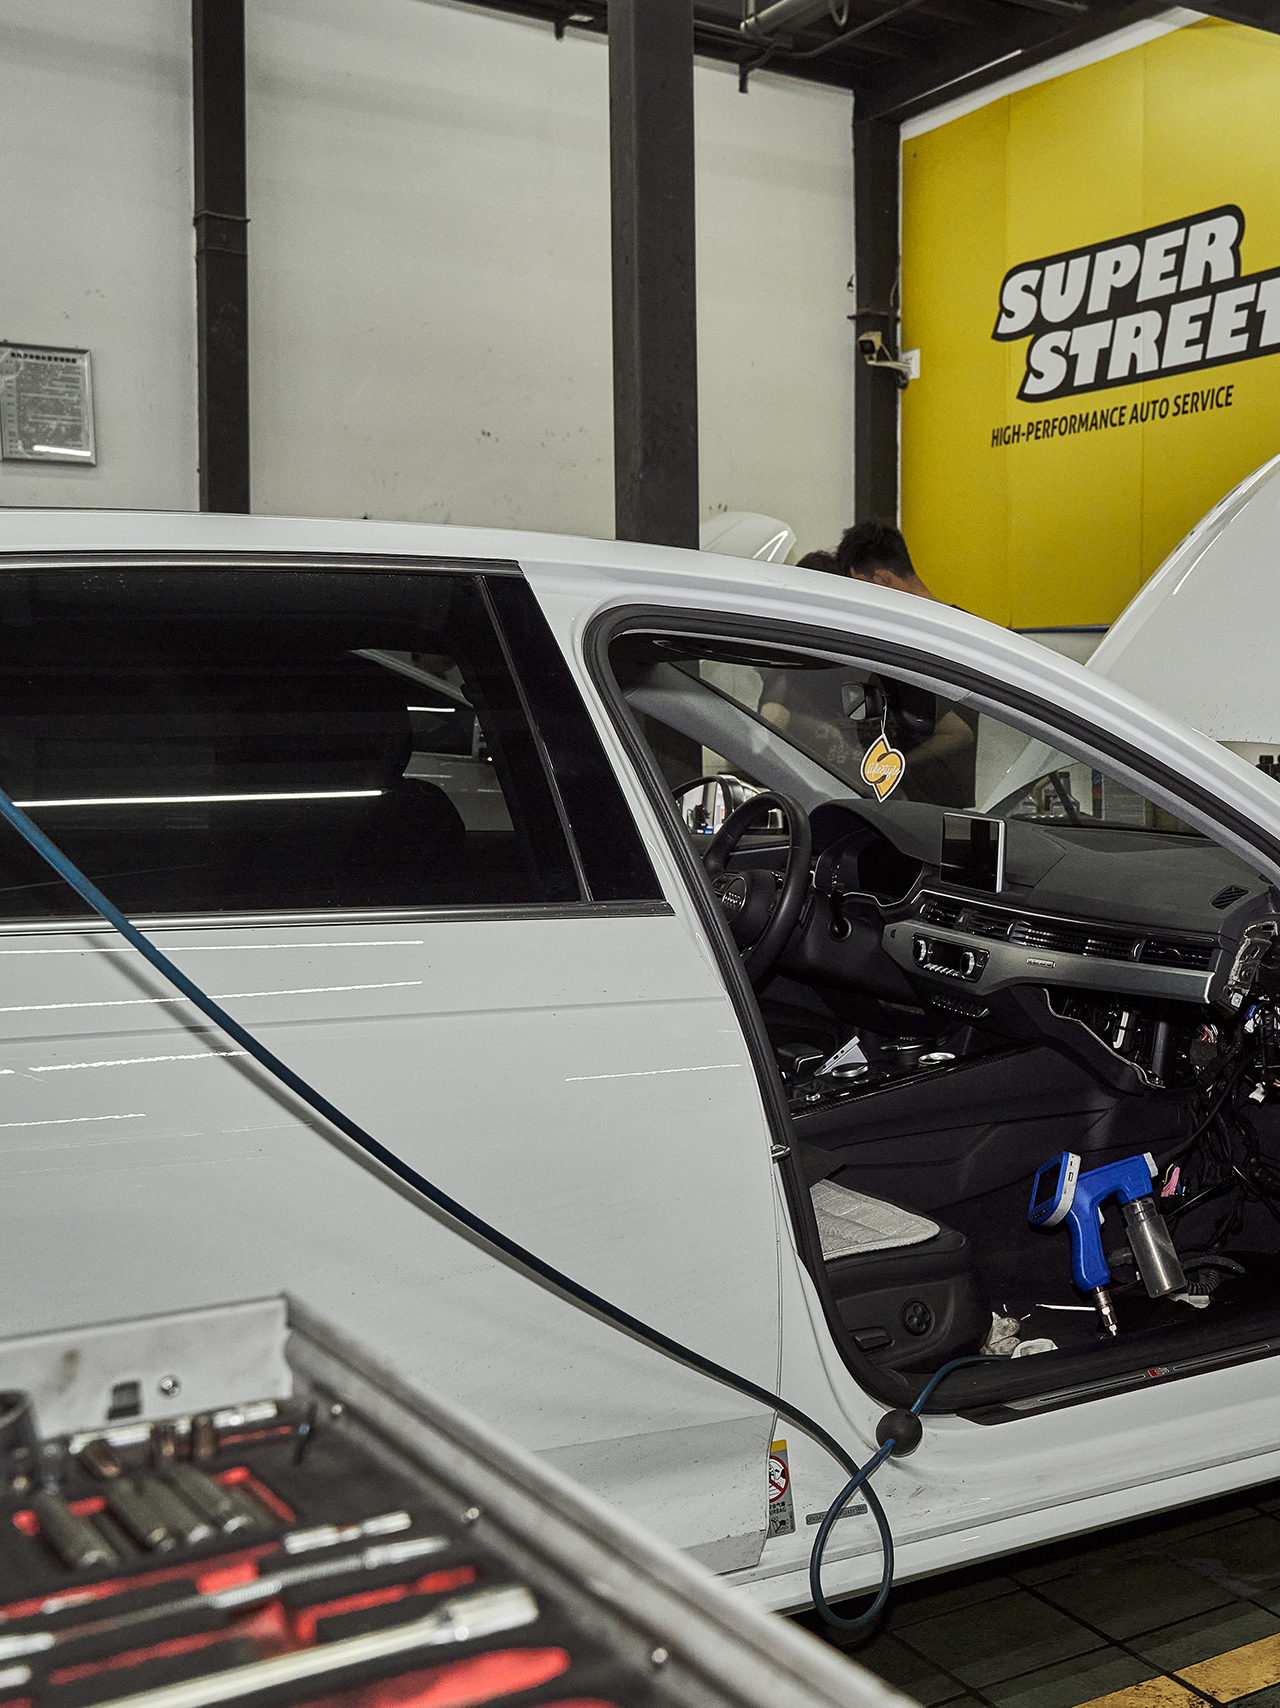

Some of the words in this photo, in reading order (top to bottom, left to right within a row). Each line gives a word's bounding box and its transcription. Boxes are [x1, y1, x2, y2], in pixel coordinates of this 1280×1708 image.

[996, 213, 1240, 335] SUPER
[990, 405, 1127, 448] HIGH-PERFORMANCE
[1129, 397, 1170, 425] AUTO
[1172, 384, 1235, 417] SERVICE
[866, 761, 902, 781] lifestyle
